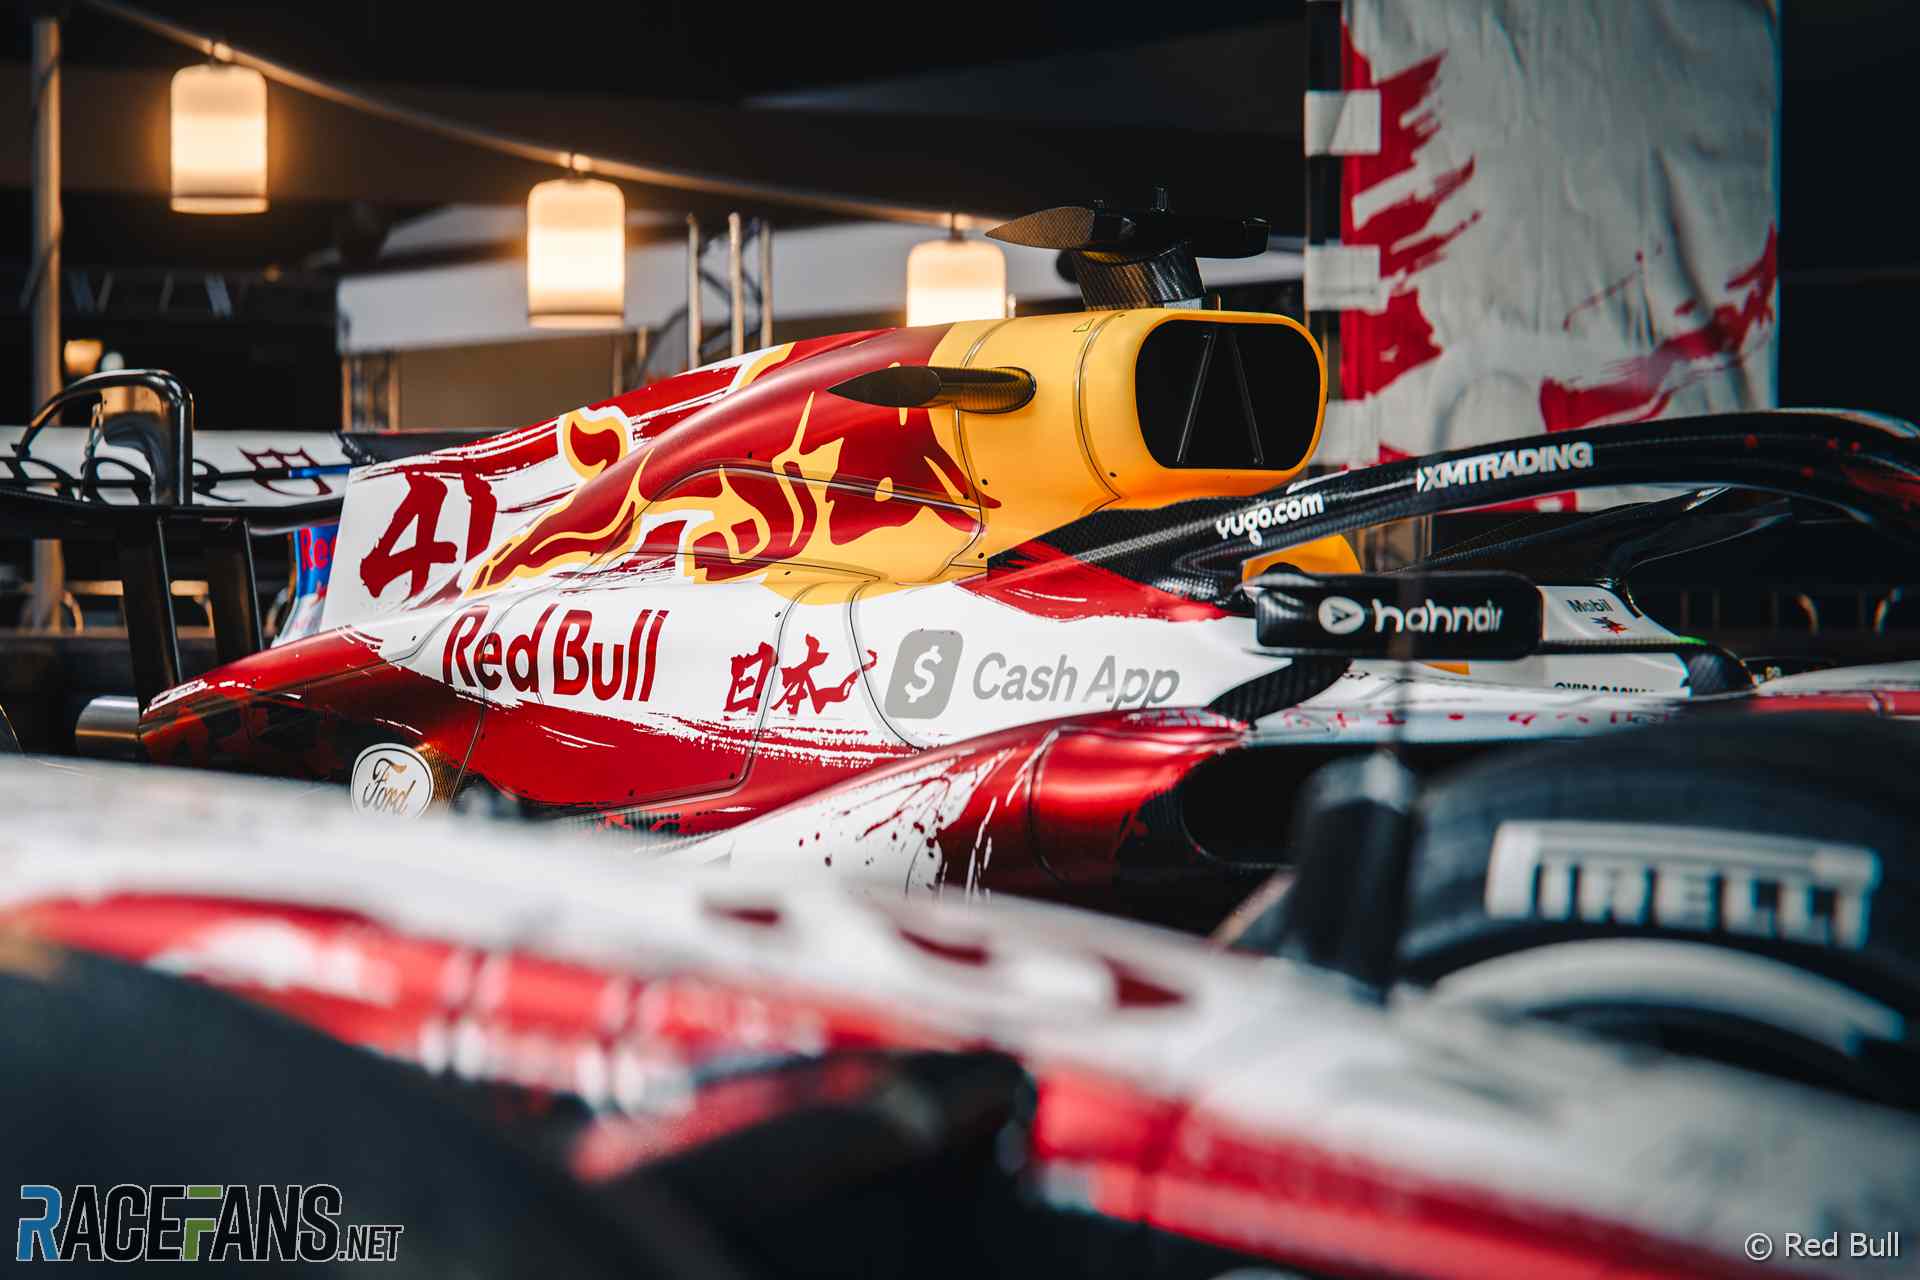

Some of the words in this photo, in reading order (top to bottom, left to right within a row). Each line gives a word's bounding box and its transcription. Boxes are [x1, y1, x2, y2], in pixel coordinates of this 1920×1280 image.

[1216, 491, 1325, 547] yugo.com
[1372, 598, 1504, 633] hahnair
[1566, 599, 1614, 613] Mobil
[443, 603, 560, 693] Red
[553, 609, 670, 702] Bull
[723, 633, 878, 715] 日本
[972, 652, 1077, 702] Cash
[1085, 655, 1181, 707] App
[363, 758, 416, 815] Ford
[1485, 820, 1882, 950] PIRELLI
